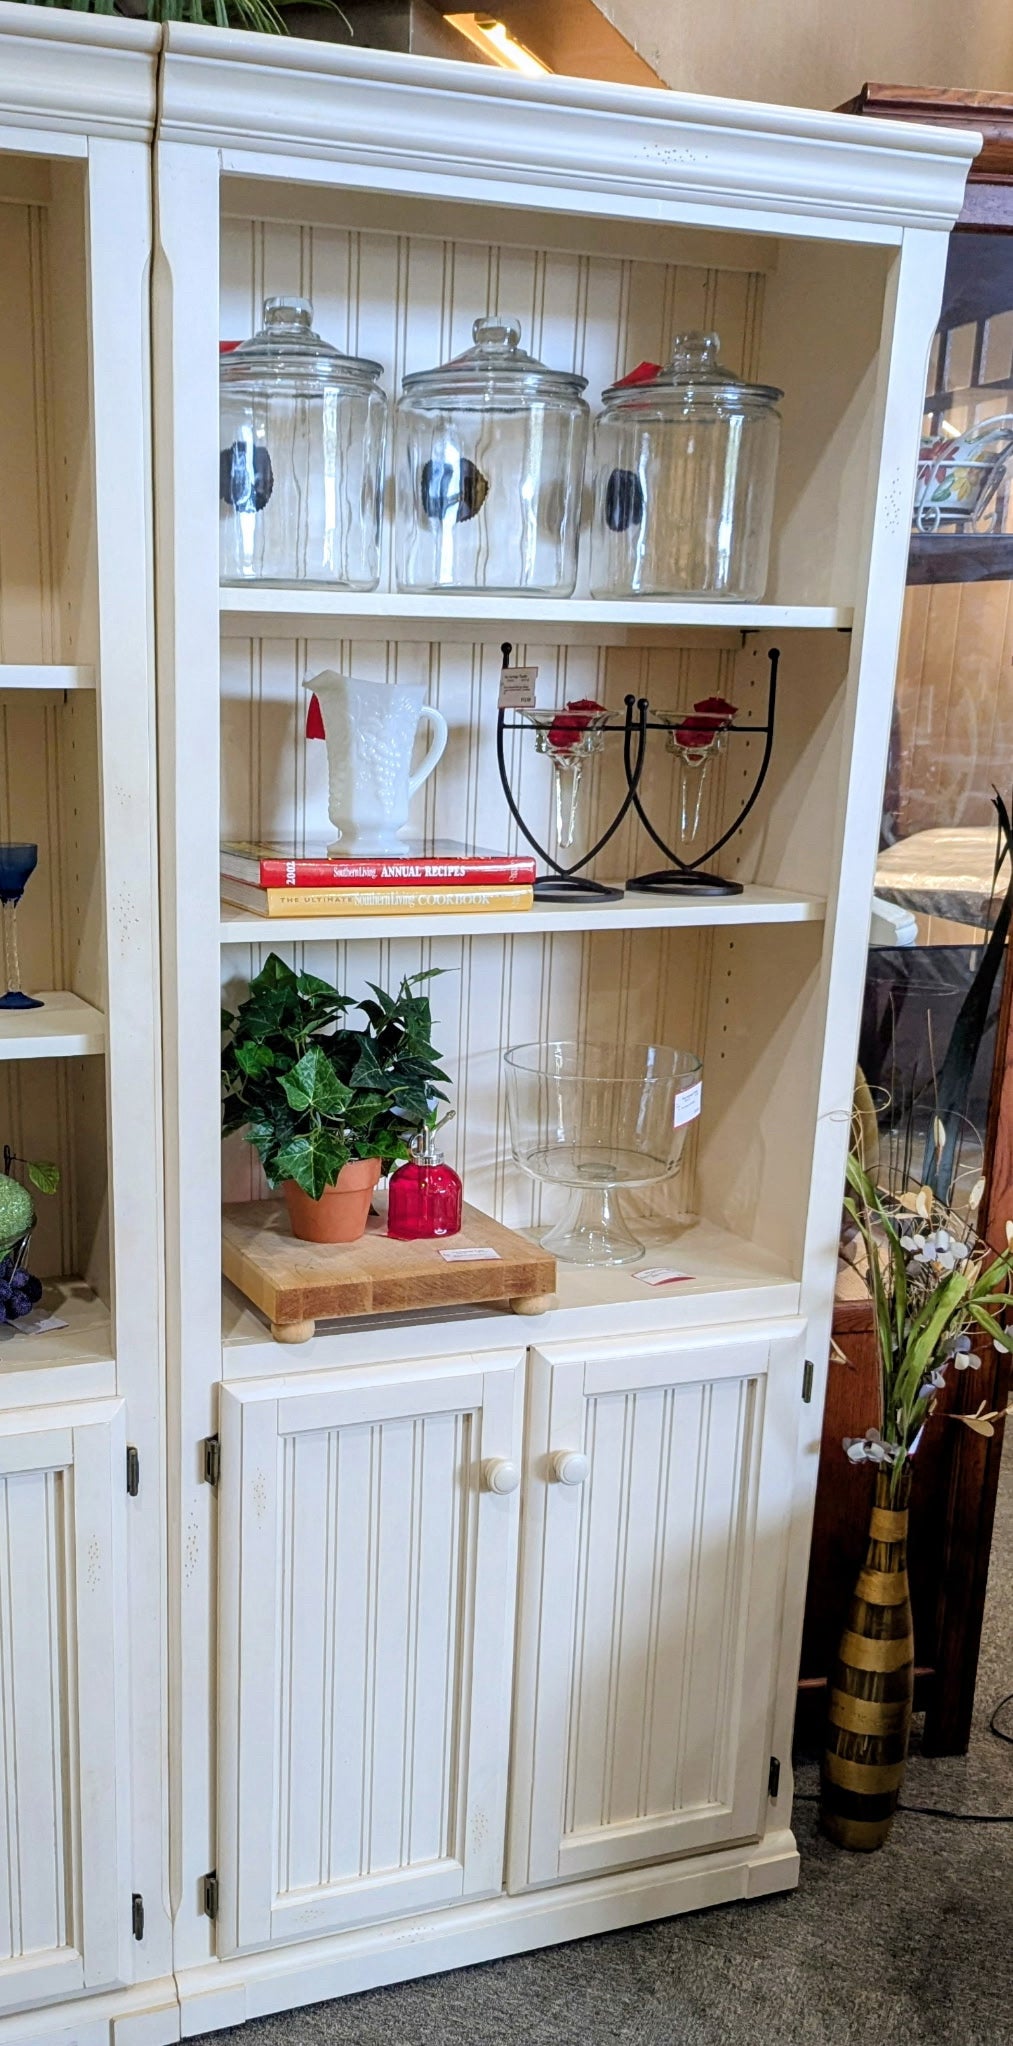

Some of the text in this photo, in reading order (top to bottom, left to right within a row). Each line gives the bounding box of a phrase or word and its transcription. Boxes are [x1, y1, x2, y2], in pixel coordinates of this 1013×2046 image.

[286, 861, 296, 885] 2002
[381, 865, 422, 878] ANNUAL
[425, 864, 466, 877] RECIPES
[304, 896, 353, 904] ULTIMATE
[418, 893, 491, 906] COOKBOOK
